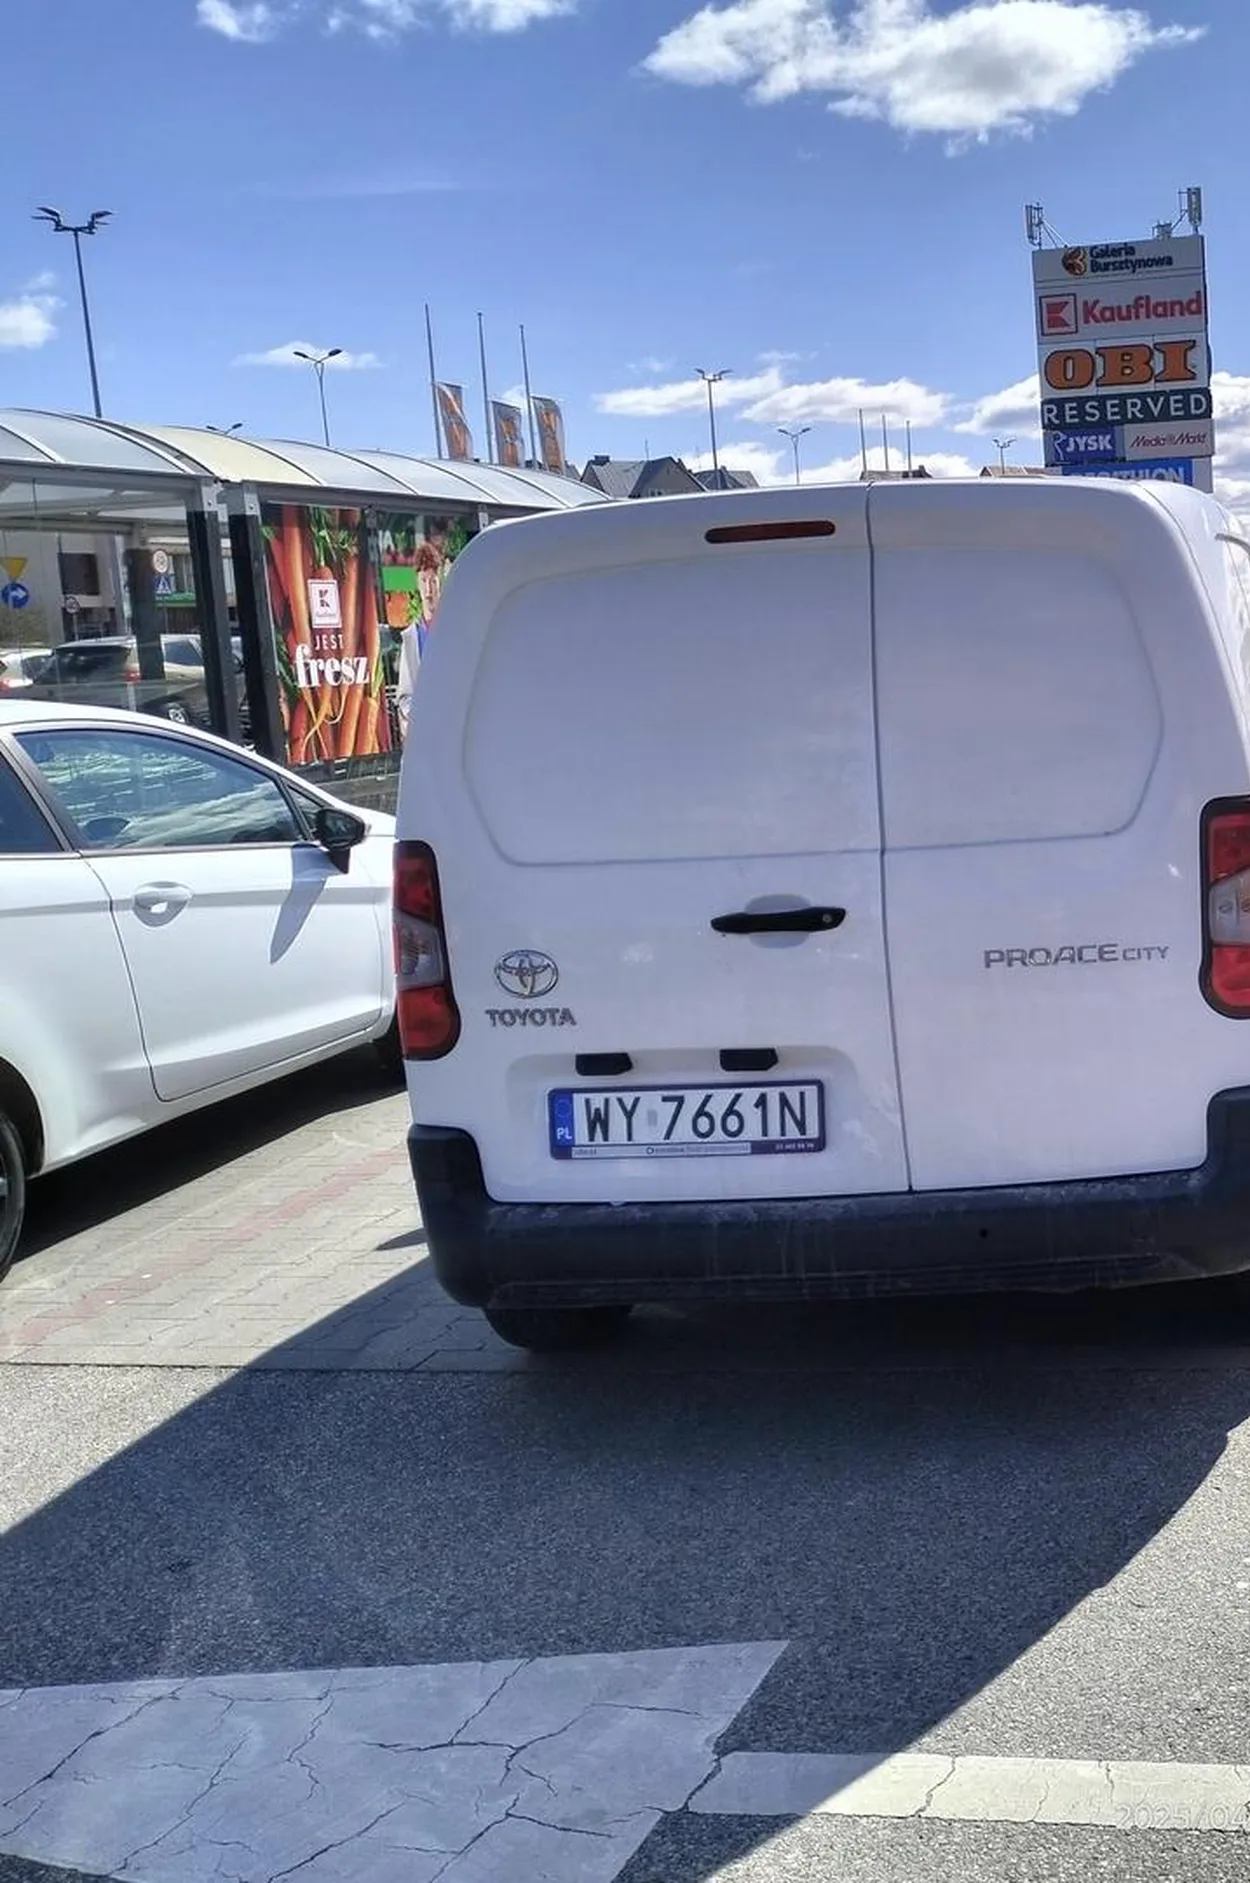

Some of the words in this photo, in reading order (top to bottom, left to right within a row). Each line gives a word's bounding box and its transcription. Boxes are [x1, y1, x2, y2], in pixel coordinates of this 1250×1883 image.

[1090, 244, 1135, 258] Galeria
[1090, 255, 1173, 273] Bursztynowa
[1082, 290, 1202, 324] Kaufland
[1044, 340, 1197, 390] OBI
[1043, 394, 1207, 425] RESERVED
[1066, 435, 1112, 453] JYSK
[1130, 434, 1166, 447] Media
[315, 634, 344, 650] JEST
[295, 643, 370, 688] fresz
[984, 943, 1119, 968] PROACE
[1121, 946, 1170, 961] CITY
[484, 1007, 578, 1028] TOYOTA
[584, 1096, 641, 1143] WY
[660, 1090, 807, 1141] 7661N
[556, 1127, 572, 1140] PL
